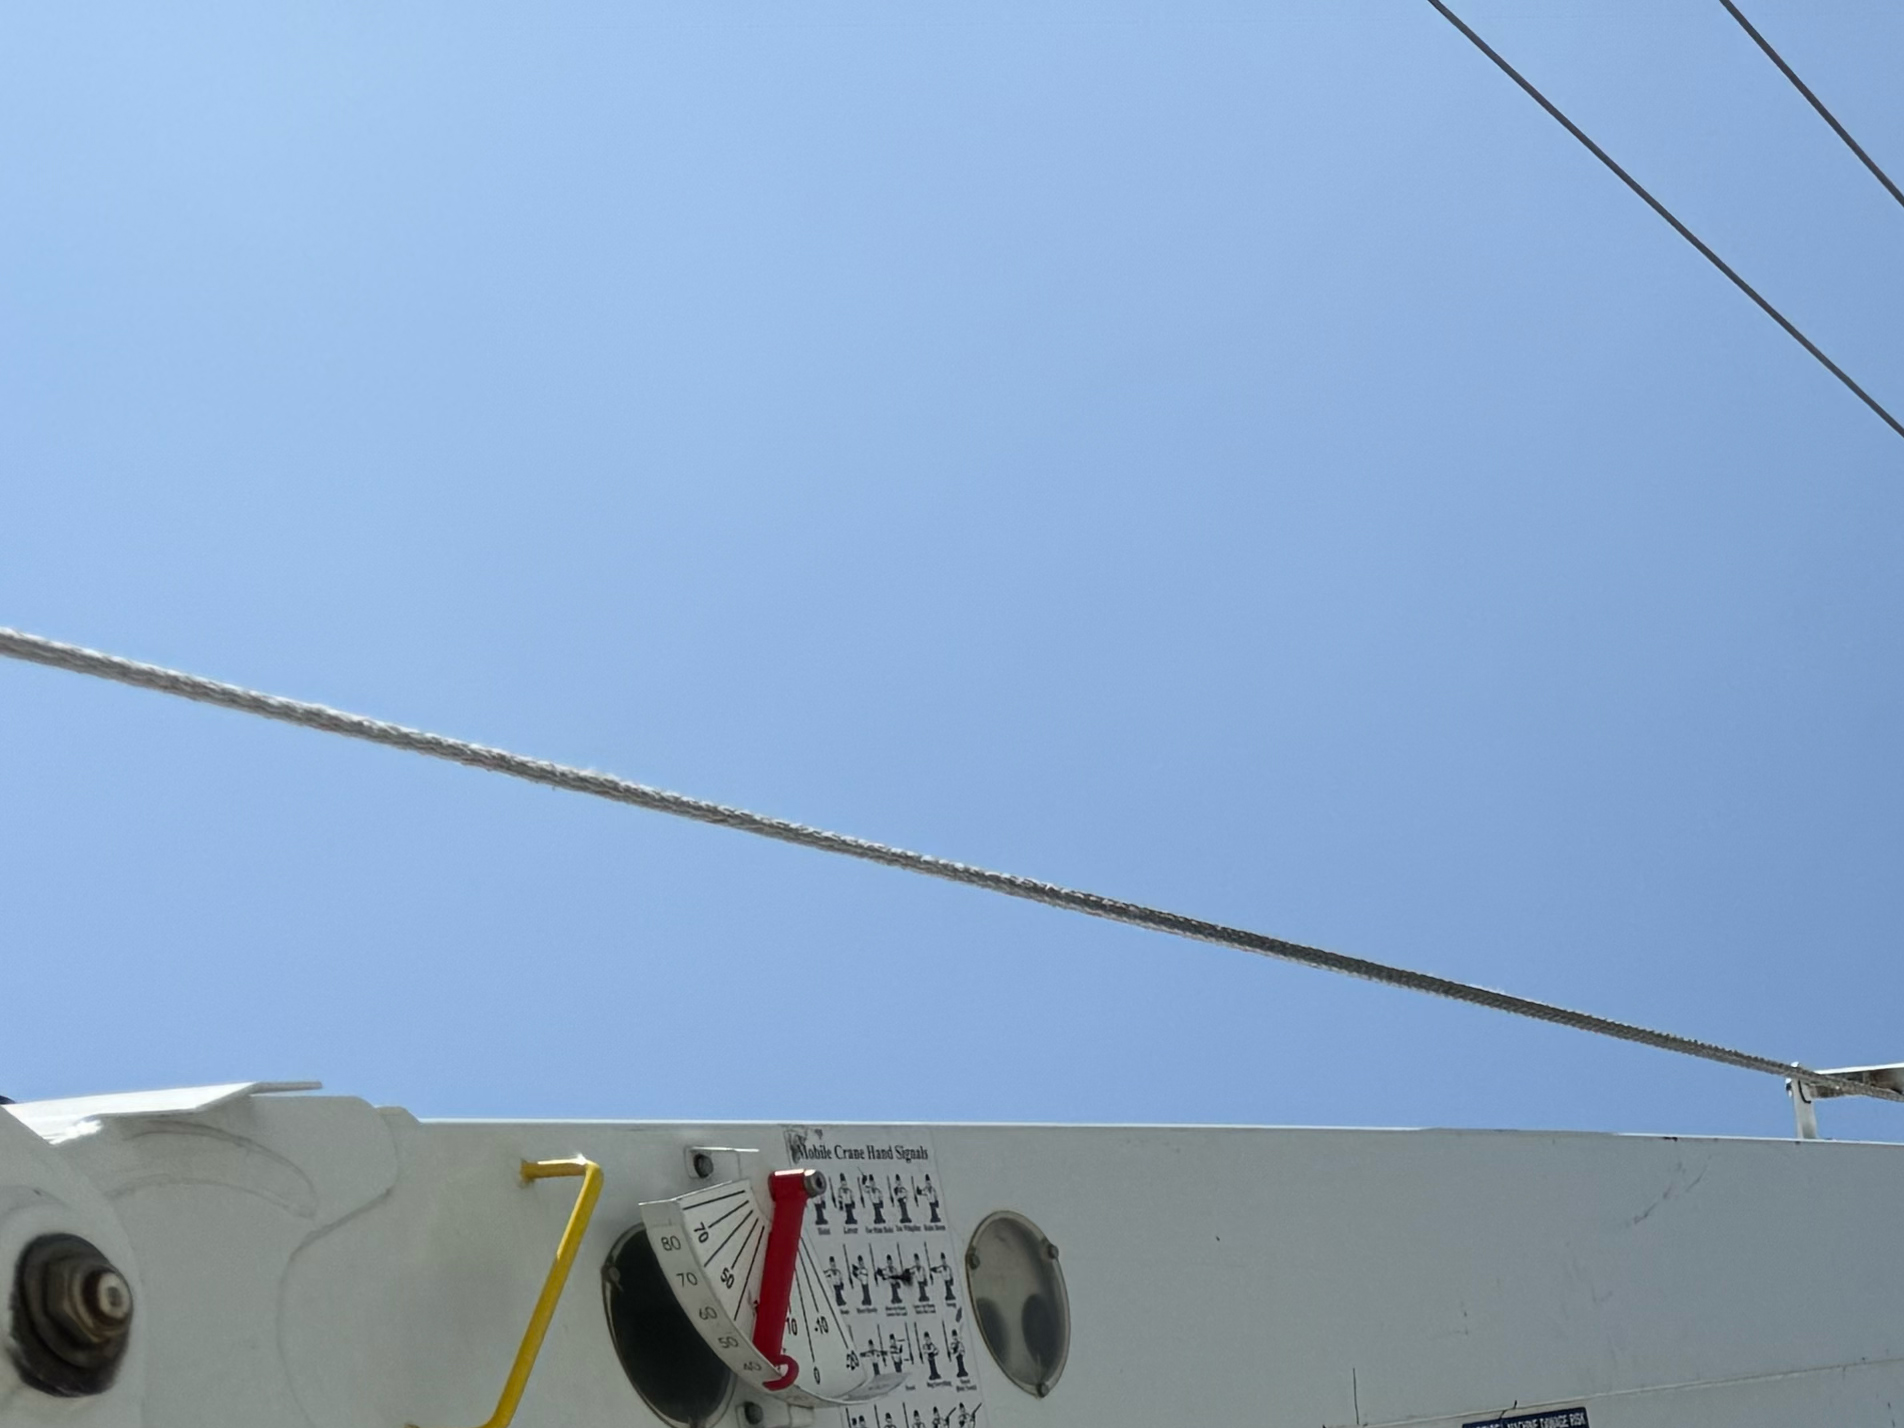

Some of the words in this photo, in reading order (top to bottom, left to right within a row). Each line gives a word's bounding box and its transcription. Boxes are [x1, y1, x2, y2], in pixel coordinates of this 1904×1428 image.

[799, 1144, 832, 1160] Mobile
[834, 1144, 865, 1160] Crane
[866, 1144, 893, 1160] Hand
[895, 1144, 928, 1163] Signals
[694, 1222, 709, 1243] 70
[661, 1235, 681, 1251] 80
[676, 1272, 698, 1287] 70
[720, 1267, 735, 1289] 50
[699, 1306, 718, 1321] 60
[814, 1316, 829, 1334] -10
[718, 1336, 739, 1349] 50
[814, 1367, 821, 1384] 0
[1569, 1412, 1586, 1427] RISK
